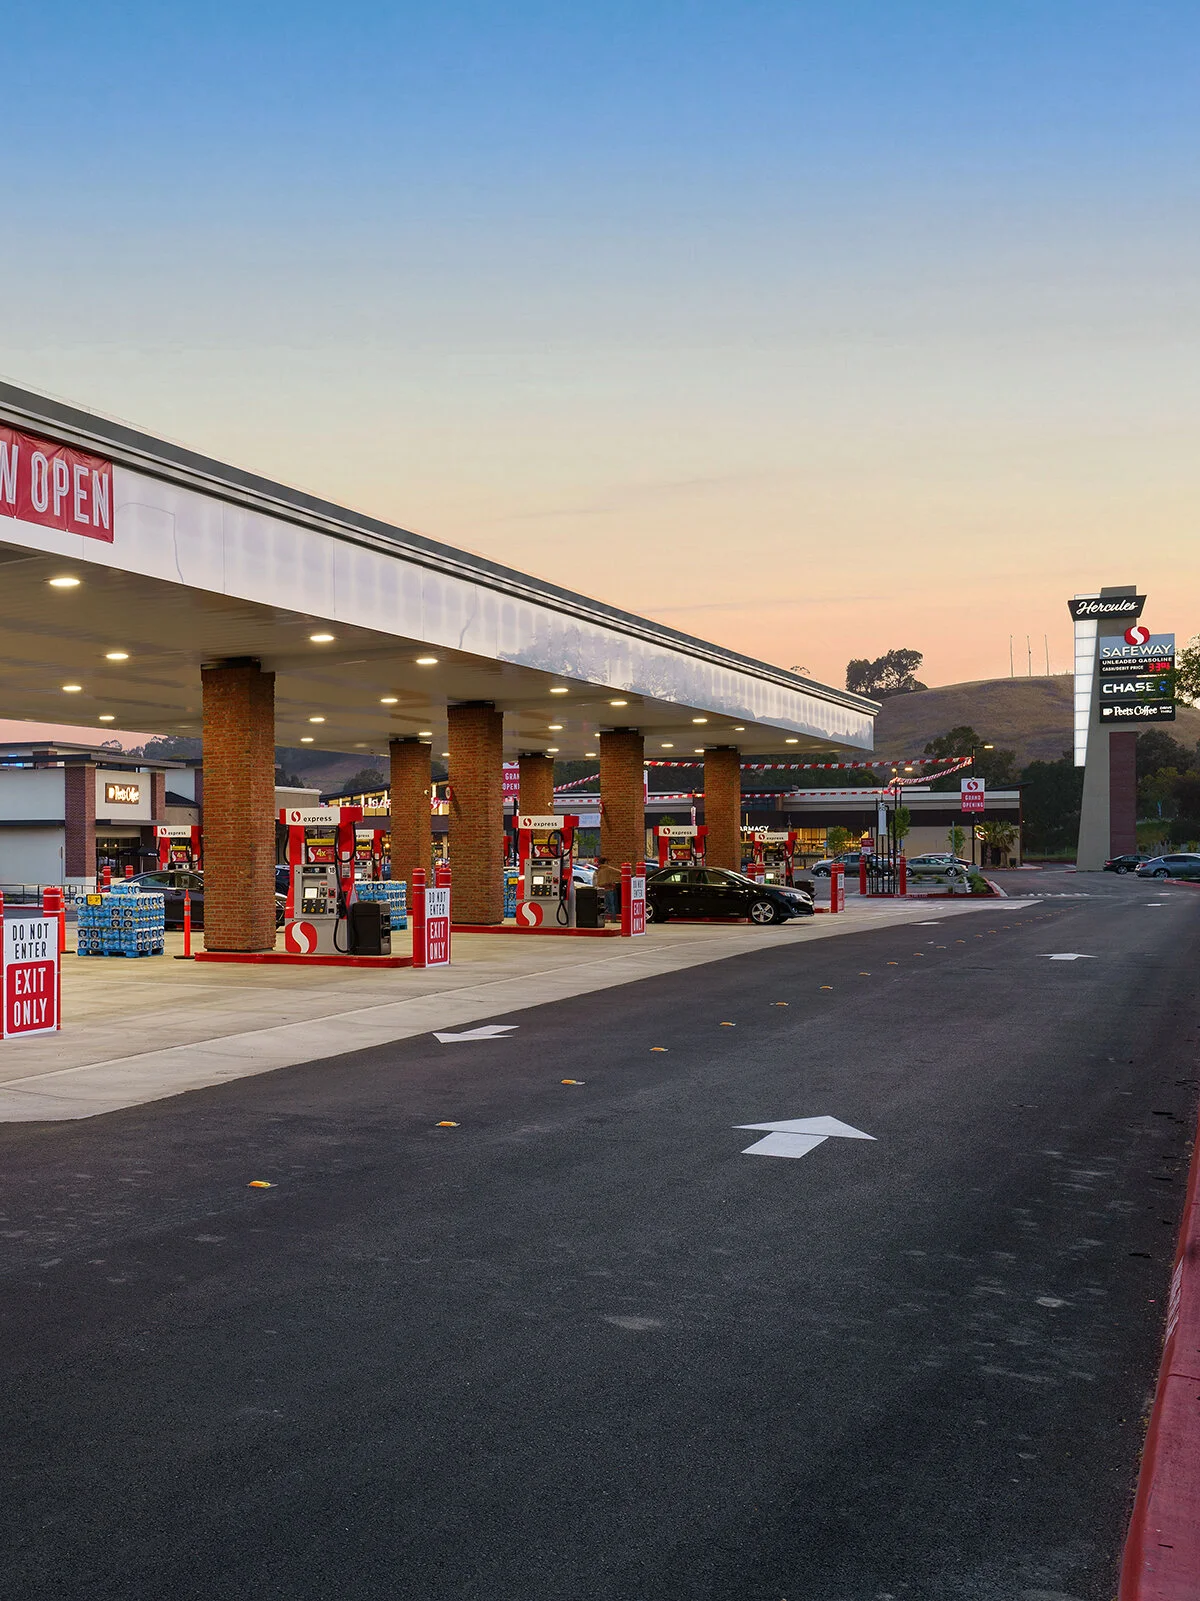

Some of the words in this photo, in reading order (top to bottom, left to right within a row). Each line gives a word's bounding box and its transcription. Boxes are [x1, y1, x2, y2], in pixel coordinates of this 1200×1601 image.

[31, 451, 110, 529] OPEN
[1076, 600, 1138, 615] Hercules
[1102, 644, 1172, 658] SAFEWAY
[1102, 682, 1156, 694] CHASE
[1134, 705, 1158, 716] Coffee
[428, 892, 435, 903] DO
[437, 892, 446, 902] NOT
[430, 904, 445, 915] ENTER
[12, 924, 24, 941] DO
[30, 923, 49, 939] NOT
[430, 921, 444, 939] EXIT
[15, 942, 47, 959] ENTER
[430, 942, 445, 960] ONLY
[15, 967, 46, 995] EXIT
[14, 998, 48, 1027] ONLY
